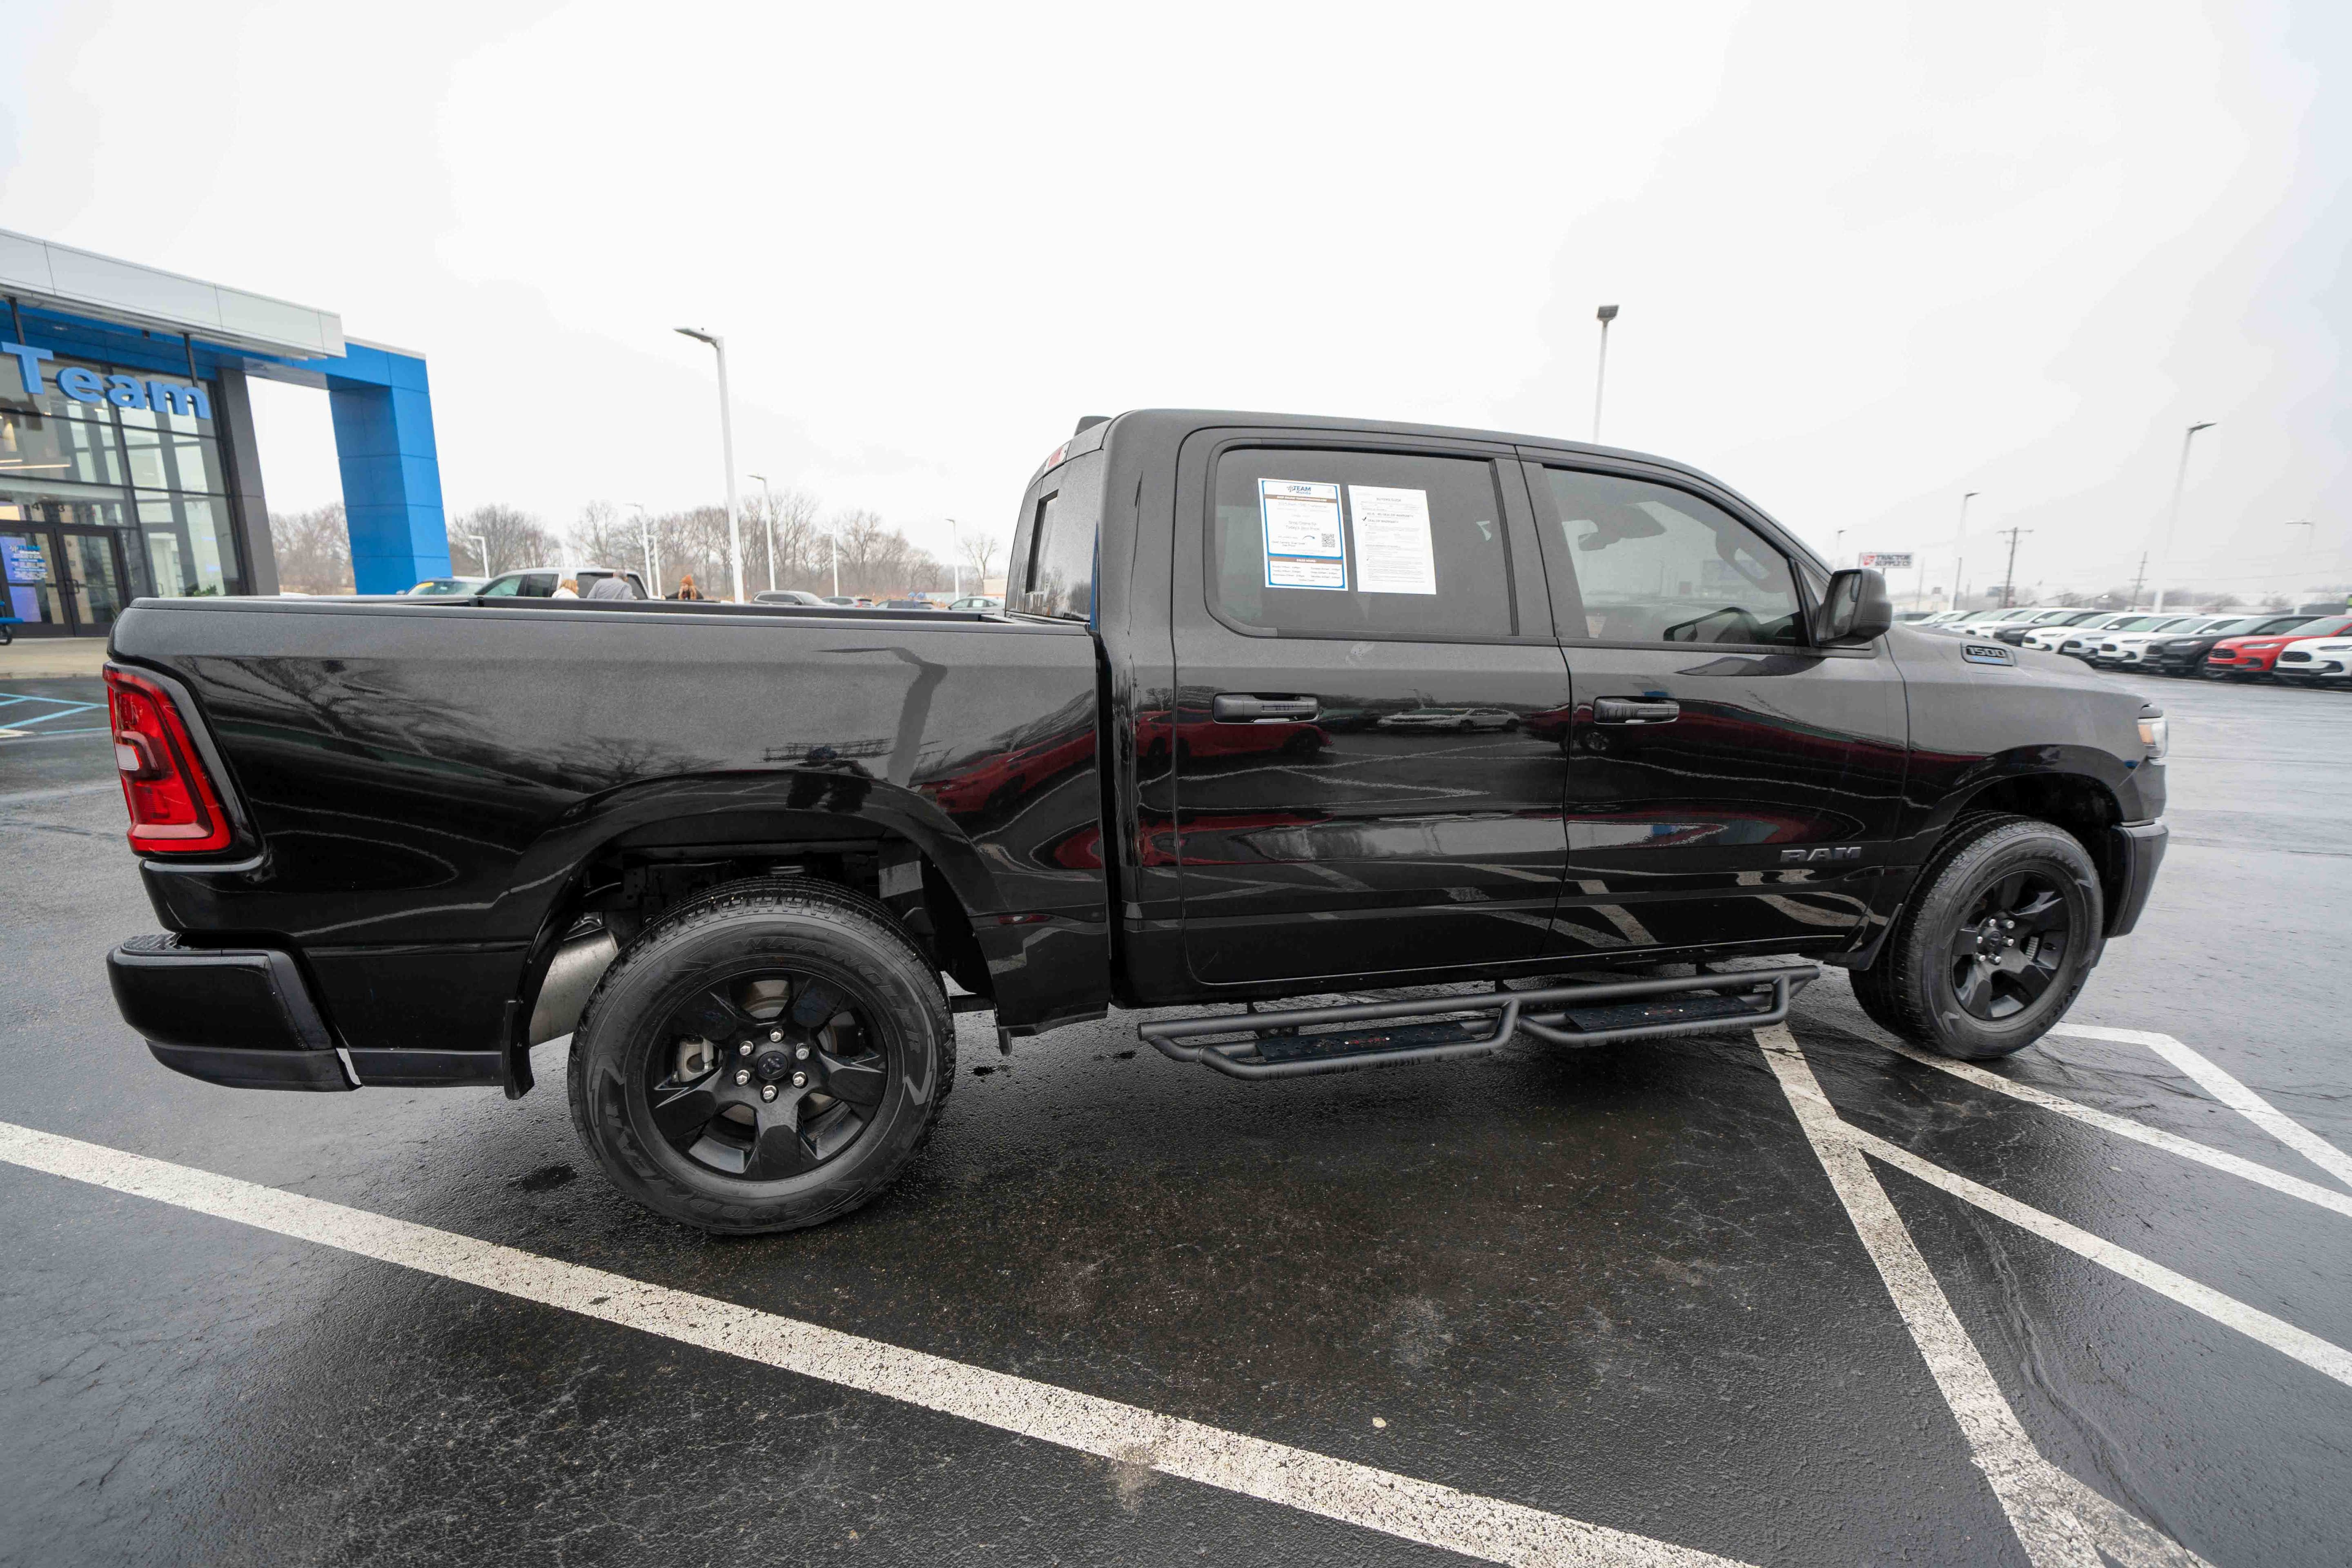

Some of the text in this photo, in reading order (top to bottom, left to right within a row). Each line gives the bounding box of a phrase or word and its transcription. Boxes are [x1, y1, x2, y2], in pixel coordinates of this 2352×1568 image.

[0, 341, 212, 419] Team
[1969, 647, 2005, 657] 1500
[1780, 847, 1861, 862] RAM
[730, 936, 922, 1055] WRANGLER
[604, 1102, 812, 1220] GOODYEAR
